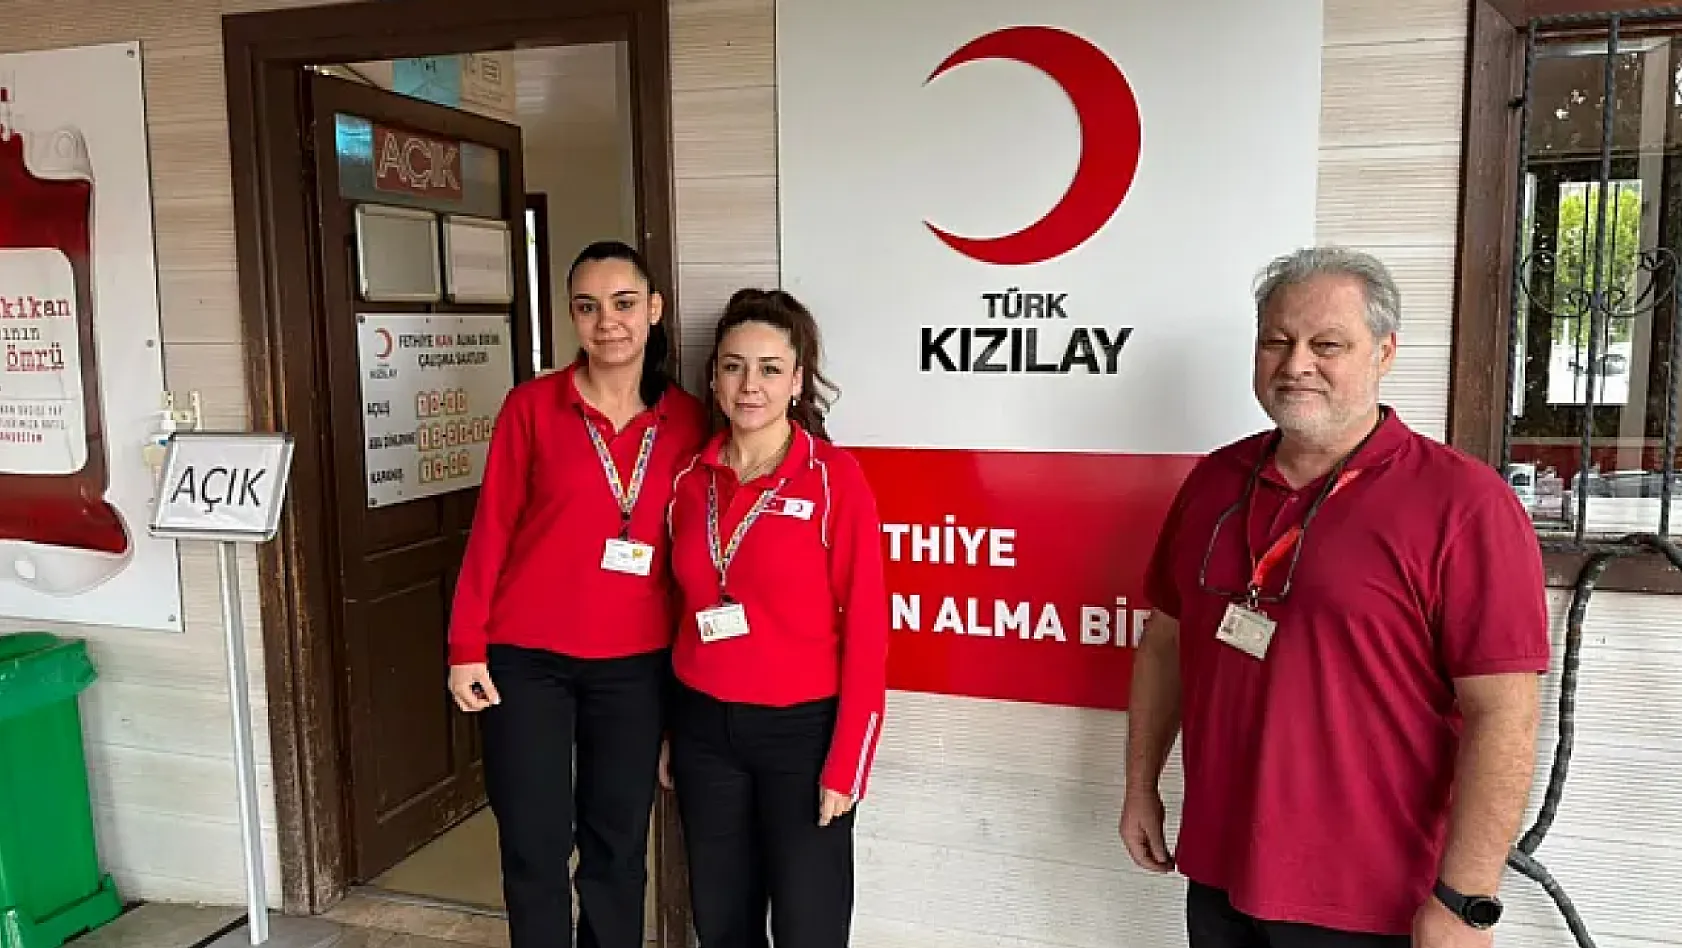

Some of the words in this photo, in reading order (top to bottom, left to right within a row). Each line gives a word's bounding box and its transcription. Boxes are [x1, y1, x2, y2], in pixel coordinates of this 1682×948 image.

[0, 296, 71, 319] kikan
[981, 287, 1068, 319] TÜRK
[0, 327, 41, 341] ının
[920, 327, 1134, 375] KIZILAY
[6, 342, 65, 372] ömrü
[171, 465, 266, 514] AÇIK
[879, 514, 1017, 567] THİYE
[891, 592, 921, 632] N
[932, 597, 1068, 642] ALMA
